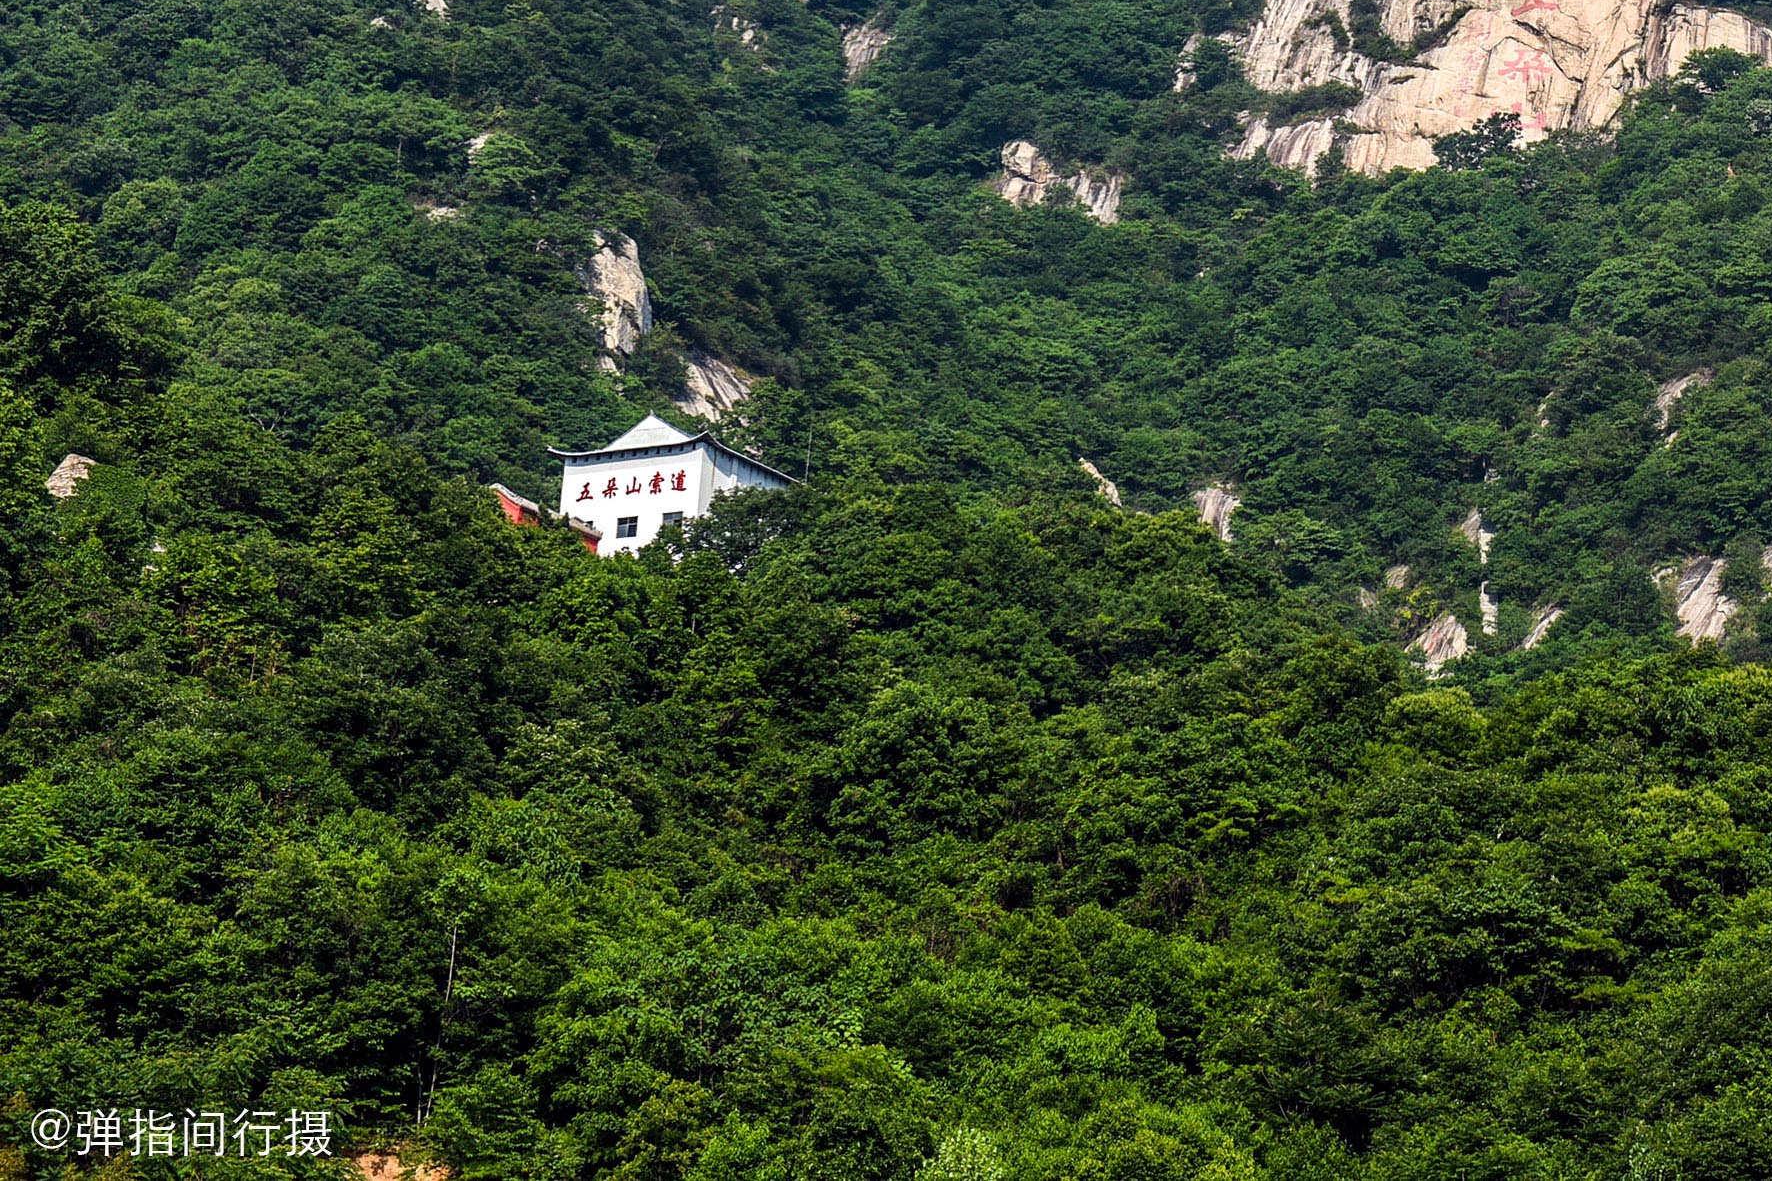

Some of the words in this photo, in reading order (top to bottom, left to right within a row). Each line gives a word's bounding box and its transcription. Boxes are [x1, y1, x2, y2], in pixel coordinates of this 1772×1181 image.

[576, 470, 687, 503] 五朵山索道
